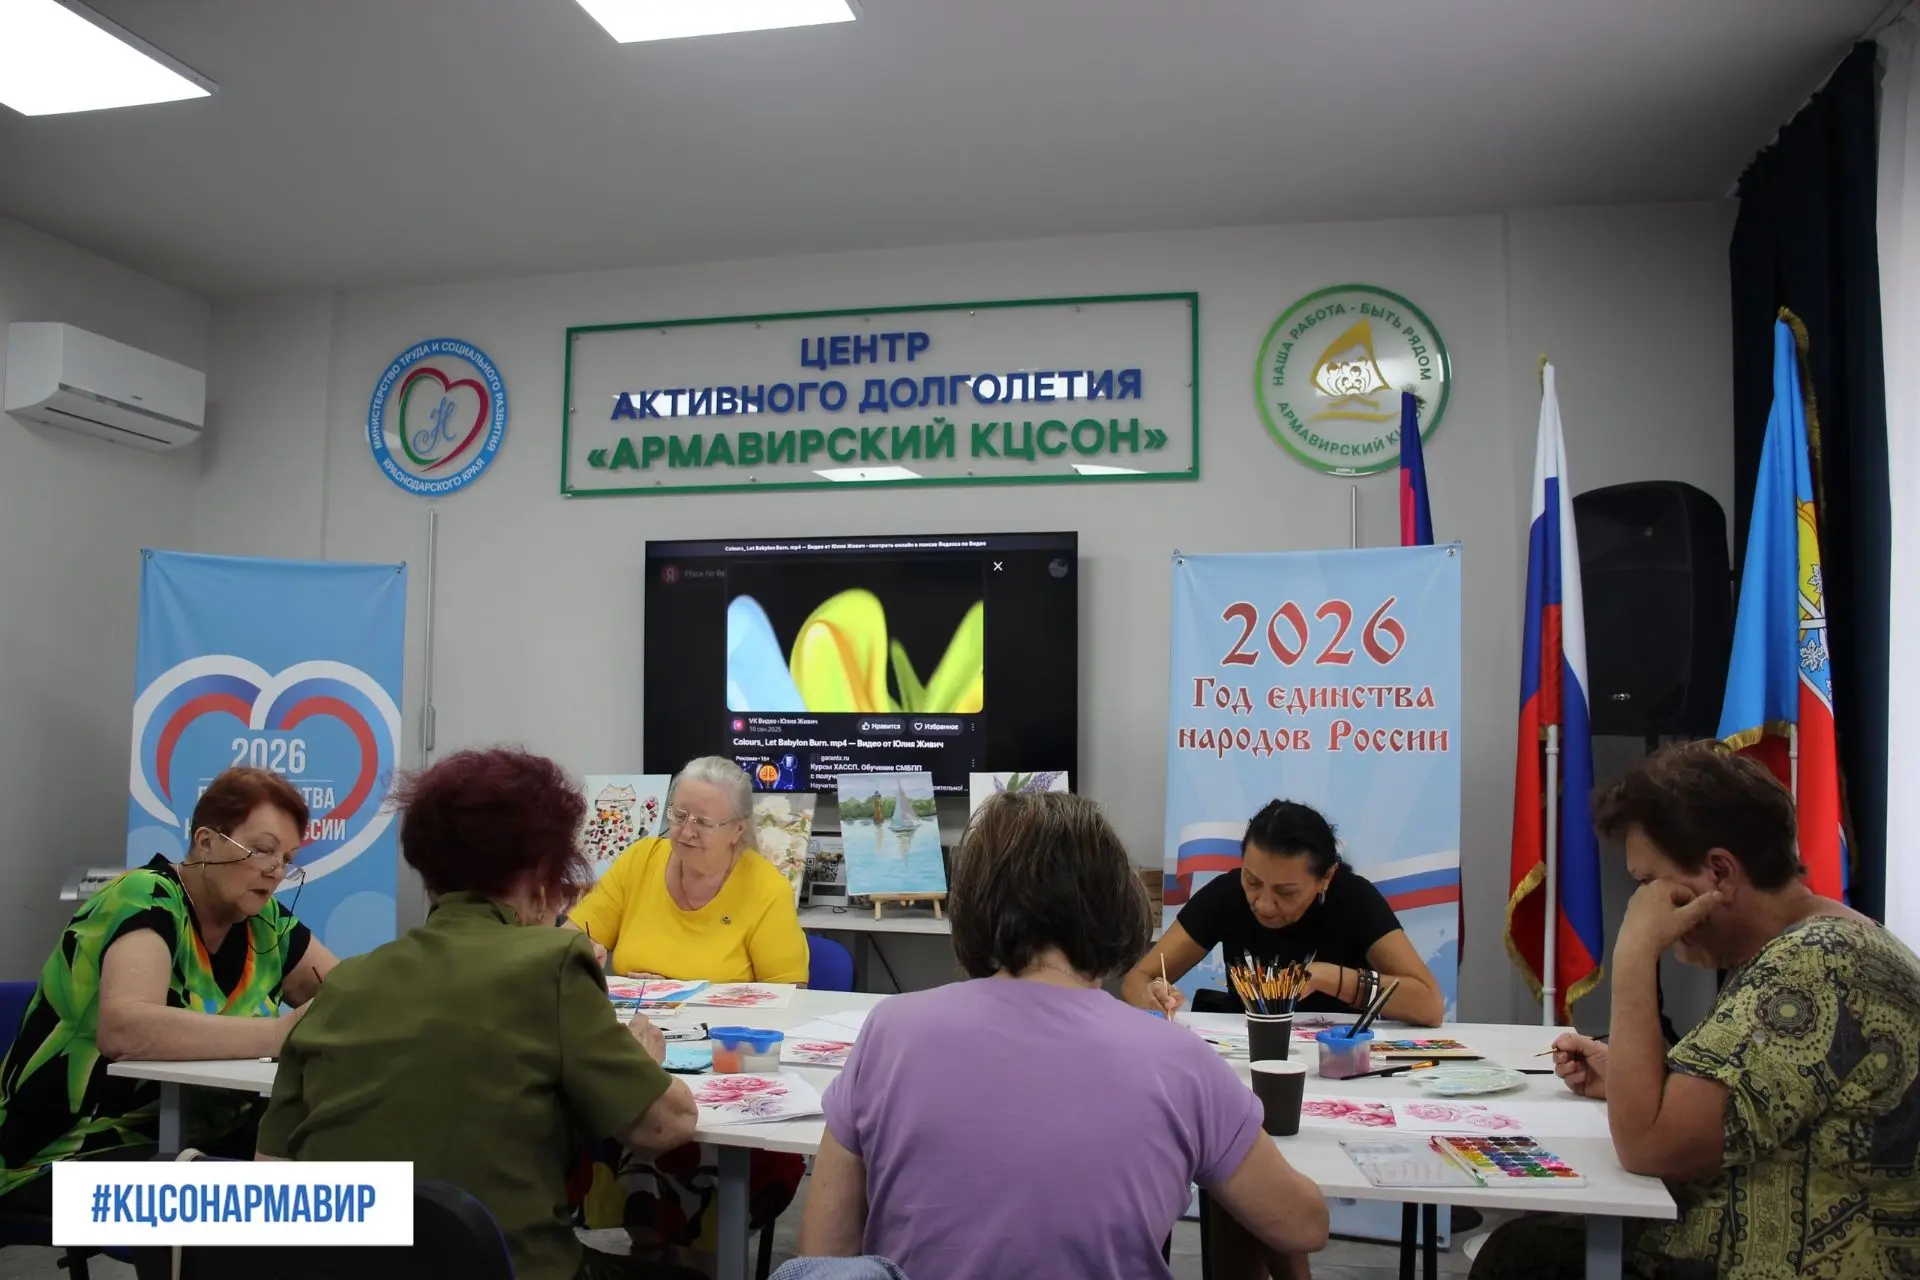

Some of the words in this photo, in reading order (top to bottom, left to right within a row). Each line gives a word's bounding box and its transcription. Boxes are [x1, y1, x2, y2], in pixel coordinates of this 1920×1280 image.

[801, 331, 930, 370] ЦЕНТР
[1273, 341, 1294, 386] НАША
[1290, 303, 1346, 340] РАБОТА
[1360, 302, 1403, 329] БЫТЬ
[1402, 326, 1432, 381] РЯДОМ
[370, 364, 401, 450] МИНИСТЕРСТВО
[400, 345, 430, 366] ТРУДА
[432, 343, 439, 351] И
[441, 342, 501, 391] СОЦИАЛЬНОГО
[487, 392, 504, 452] РАЗВИТИЯ
[610, 380, 848, 420] АКТИВНОГО
[858, 368, 1142, 414] ДОЛГОЛЕТИЯ
[587, 416, 956, 470] «АРМАВИРСКИЙ
[970, 417, 1169, 462] КЦСОН»
[1277, 402, 1386, 457] АРМАВИРСКИЙ
[383, 458, 462, 492] КРАСНОДАРСКОГО
[462, 458, 485, 481] КРАЯ
[1219, 595, 1407, 667] 2026
[1191, 676, 1253, 716] Год
[1266, 685, 1437, 716] единства
[765, 738, 777, 747] Let
[778, 738, 808, 748] Babylon
[830, 739, 847, 748] mp4
[857, 739, 882, 749] Видео
[892, 739, 916, 748] Юлия
[916, 740, 944, 749] Живич
[871, 723, 901, 731] Нравится
[924, 723, 959, 731] Избранное
[1177, 727, 1312, 759] народов
[1327, 719, 1450, 753] России
[230, 737, 306, 774] 2026
[810, 763, 833, 771] Курсы
[861, 764, 894, 772] Обучение
[810, 782, 838, 790] Научитес
